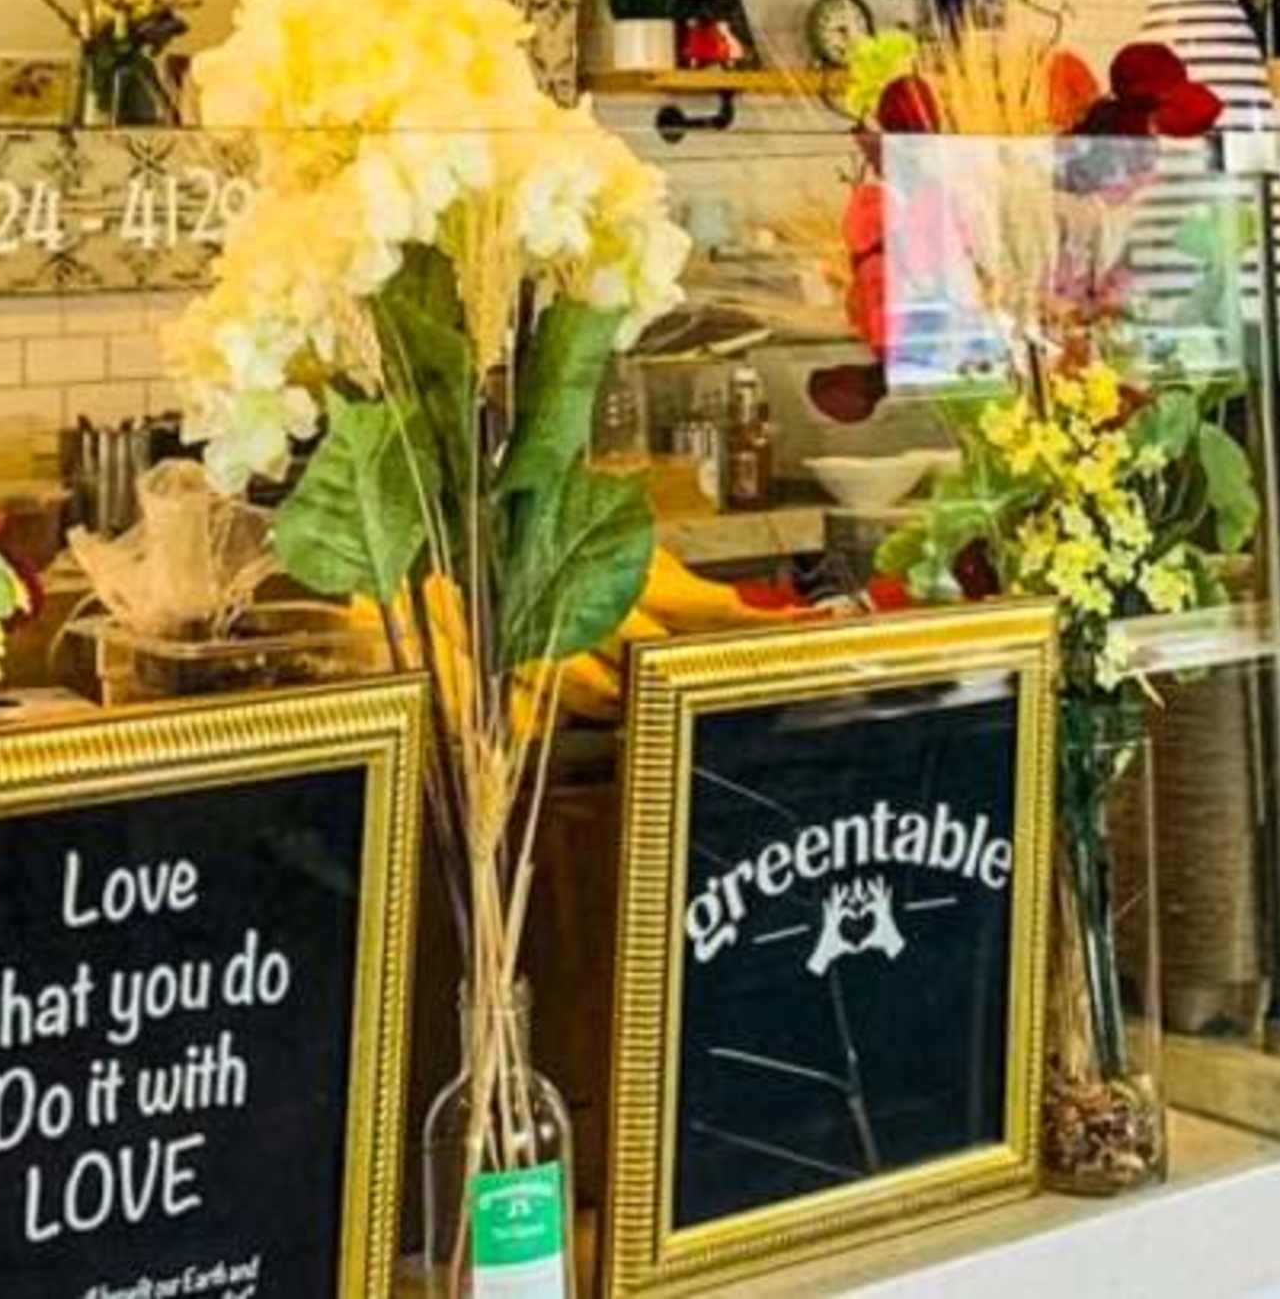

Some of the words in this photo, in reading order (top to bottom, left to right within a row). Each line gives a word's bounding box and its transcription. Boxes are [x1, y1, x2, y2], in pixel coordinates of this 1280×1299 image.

[62, 849, 199, 928] Love
[684, 800, 1012, 963] greentable
[107, 960, 213, 1045] you
[222, 928, 291, 1006] do
[87, 1058, 125, 1127] it
[137, 1030, 247, 1117] with
[25, 1133, 206, 1243] LOVE
